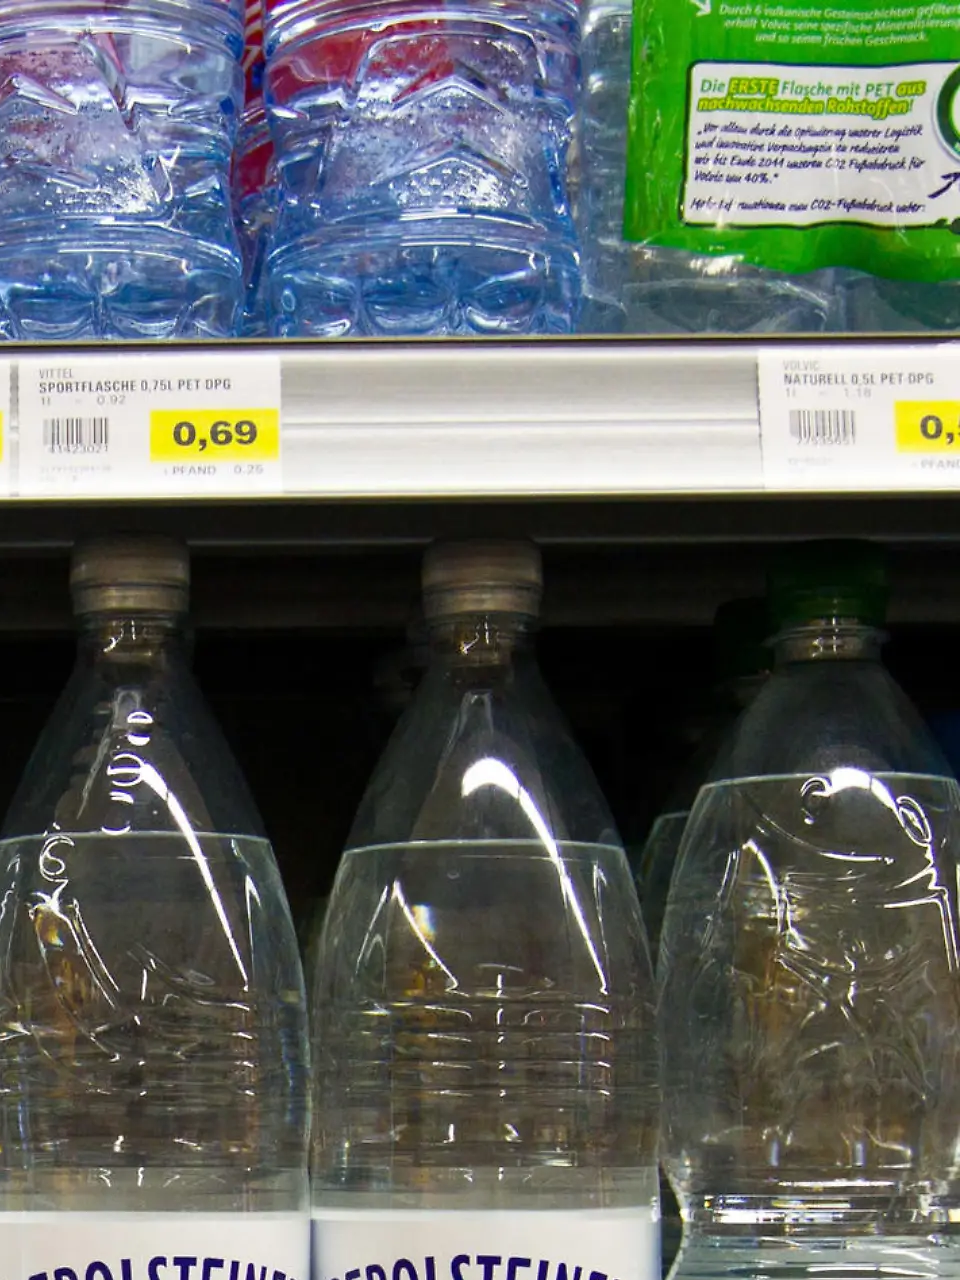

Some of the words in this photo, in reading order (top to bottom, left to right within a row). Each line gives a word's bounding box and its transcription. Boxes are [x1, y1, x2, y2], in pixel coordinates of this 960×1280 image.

[700, 78, 725, 93] Die
[729, 79, 778, 95] ERSTE
[781, 79, 833, 96] Flasche
[836, 81, 862, 95] mit
[865, 82, 894, 96] PET
[897, 82, 925, 95] aus
[698, 97, 823, 113] nachwachsenden
[783, 360, 820, 371] VOLVIC
[39, 368, 74, 380] VITTEL
[784, 372, 847, 386] NATURELL
[39, 380, 136, 394] SPORTFLASCHE
[173, 420, 258, 451] 0,69
[172, 465, 217, 476] PFAND
[233, 463, 264, 474] 0.25
